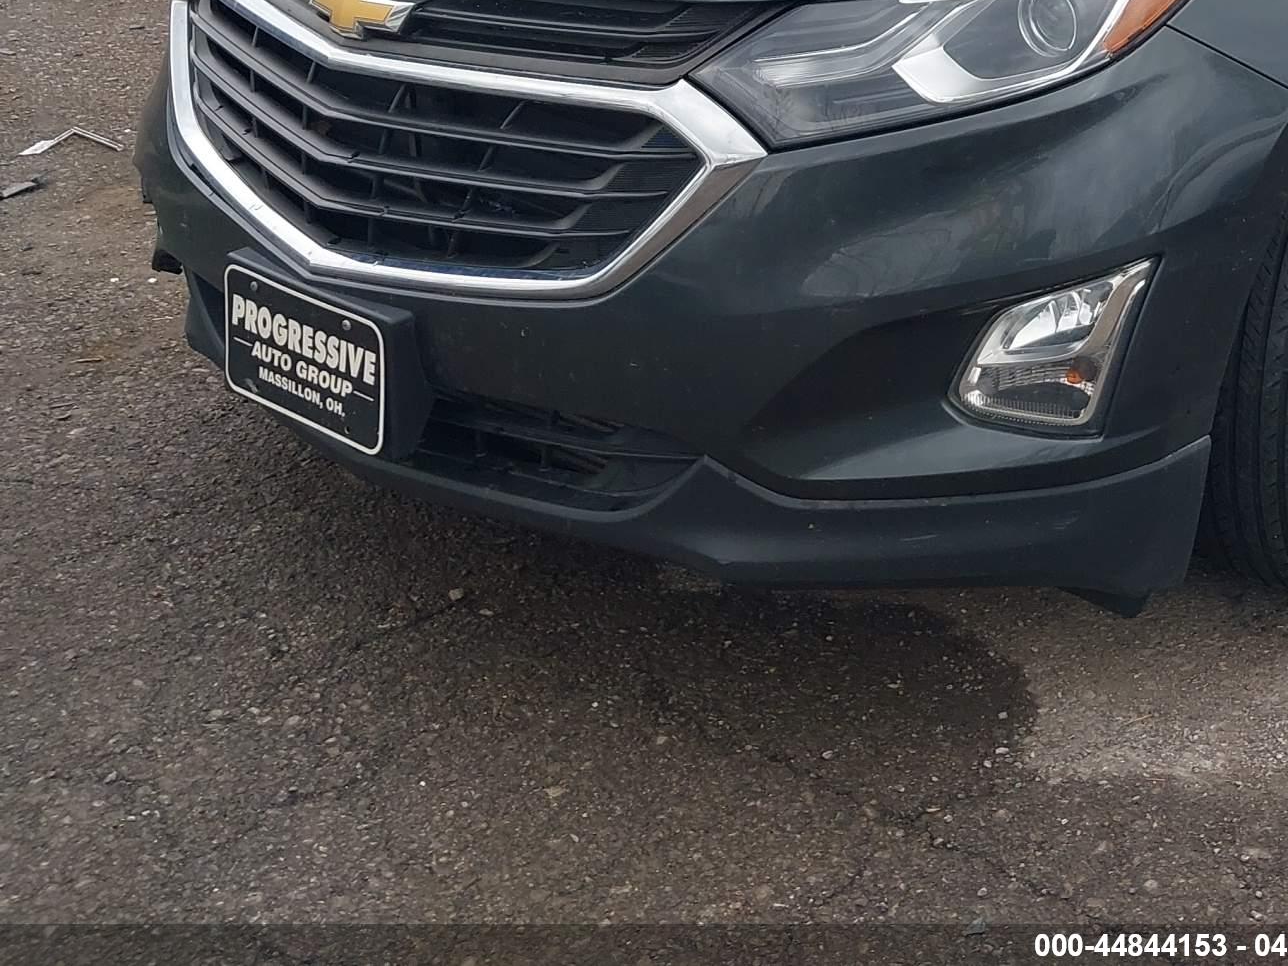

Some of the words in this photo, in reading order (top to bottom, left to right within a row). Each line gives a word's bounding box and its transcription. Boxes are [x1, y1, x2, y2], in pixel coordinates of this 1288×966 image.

[231, 295, 376, 386] PROGRESSIVE
[251, 343, 292, 372] AUTO
[295, 360, 353, 397] GROUP
[258, 367, 324, 409] MASSILLON,
[325, 397, 346, 417] OH.
